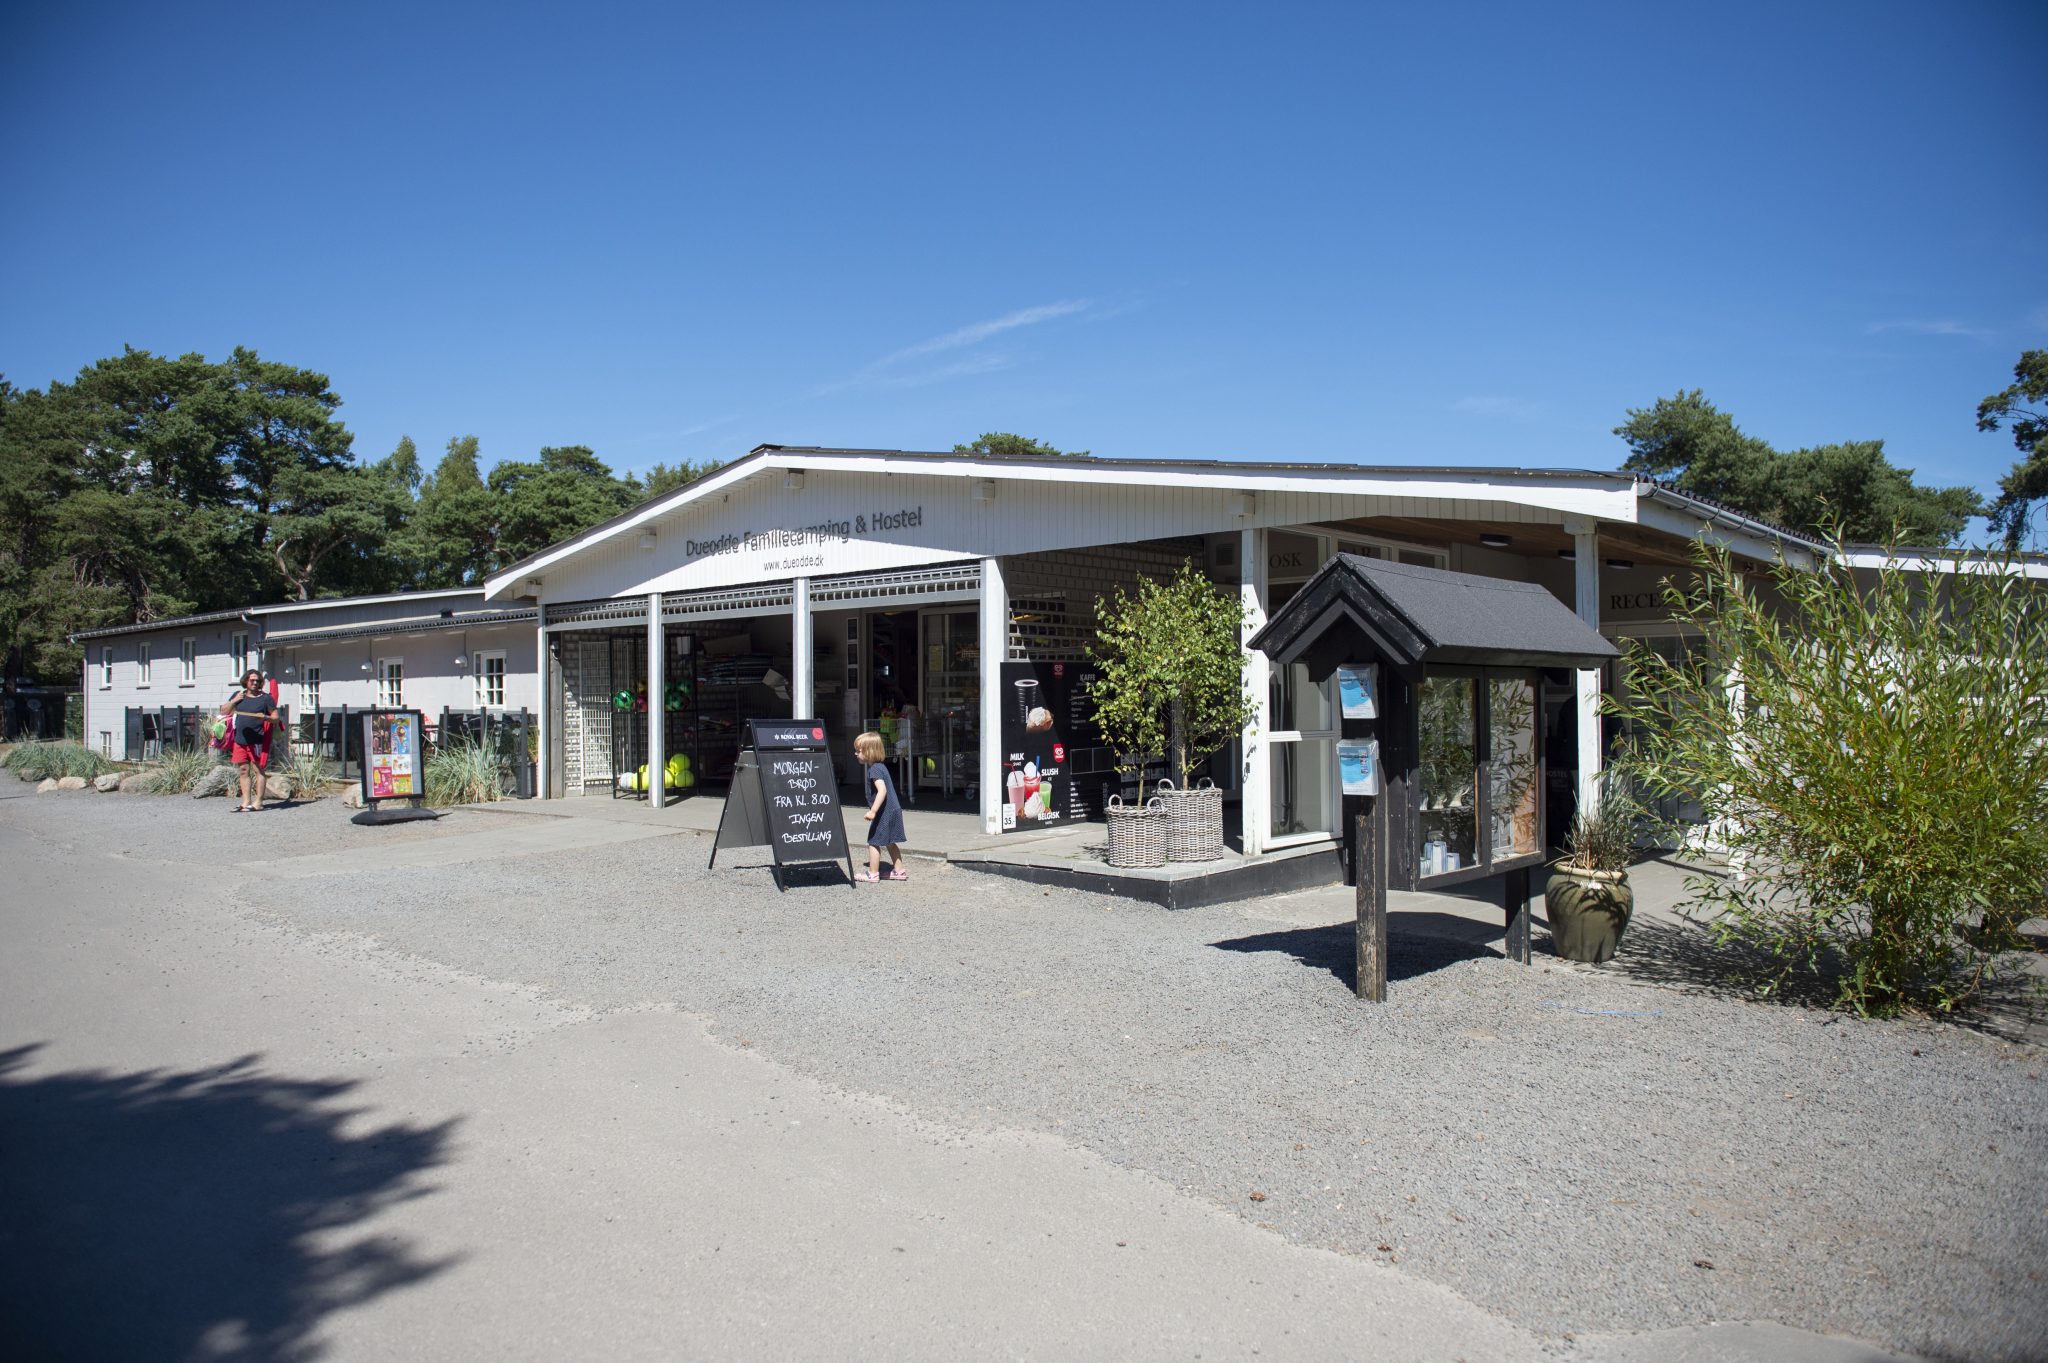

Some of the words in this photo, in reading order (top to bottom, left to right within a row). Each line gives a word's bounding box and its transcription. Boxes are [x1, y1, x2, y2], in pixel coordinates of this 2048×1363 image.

[686, 534, 740, 557] Dueodde
[743, 519, 850, 553] Familiecamping
[855, 514, 867, 534] &
[872, 505, 922, 532] Hostel
[763, 553, 825, 572] www.dueodde.dk
[1079, 673, 1096, 681] KAFFE
[1009, 753, 1025, 761] MILK
[1041, 768, 1059, 776] SLUSH
[787, 778, 817, 791] BRØD
[773, 795, 793, 808] FRA
[795, 794, 810, 806] KL.
[811, 793, 831, 805] 8.00
[788, 812, 825, 830] INGEN
[1037, 811, 1060, 821] BELGISK
